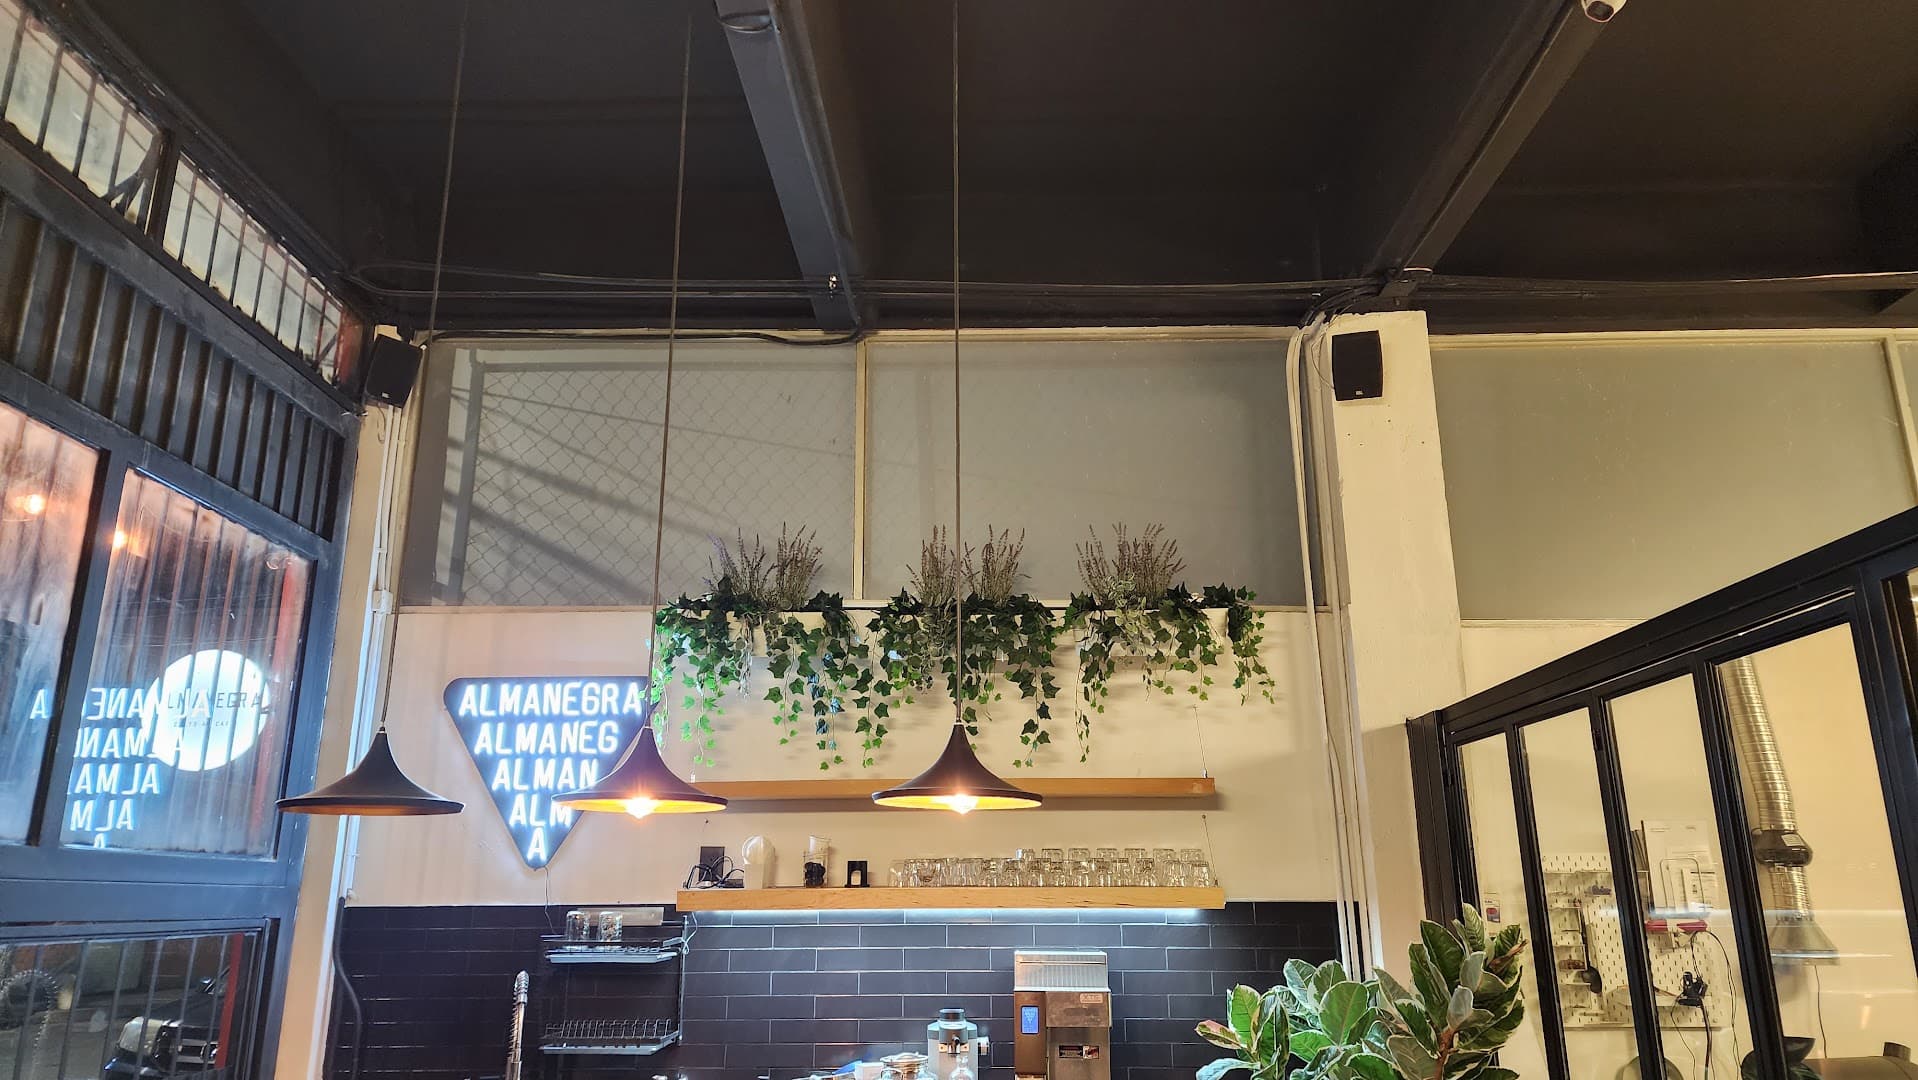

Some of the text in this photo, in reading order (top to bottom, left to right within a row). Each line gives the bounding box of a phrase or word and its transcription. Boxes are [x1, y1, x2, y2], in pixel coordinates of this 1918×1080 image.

[458, 682, 642, 716] ALMANEGRA
[474, 720, 619, 755] ALMANEG
[492, 757, 599, 790] ALMAN
[509, 794, 572, 826] ALM
[526, 827, 548, 860] A
